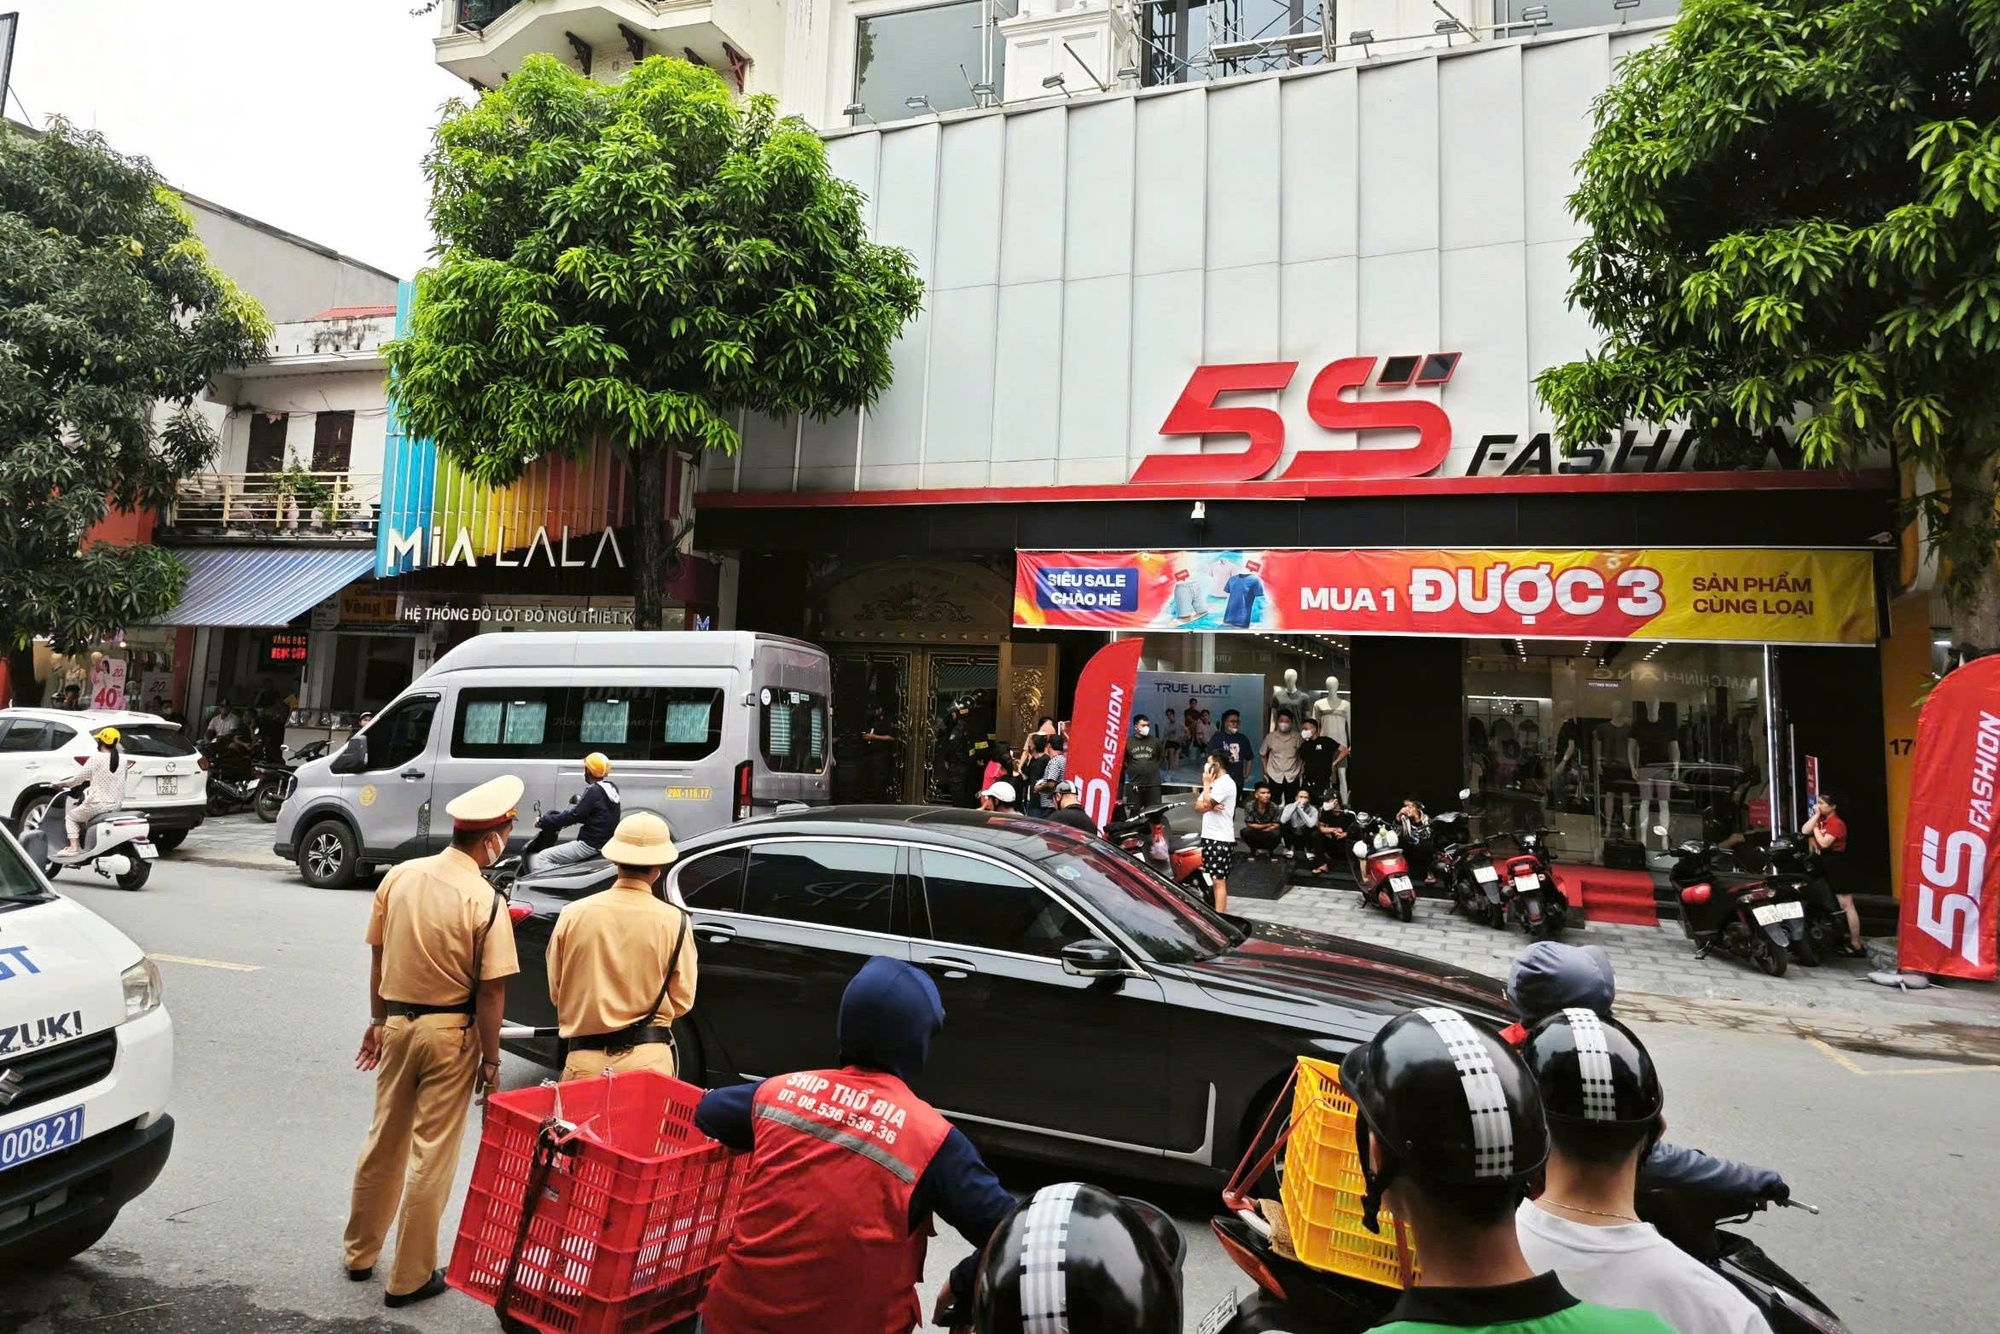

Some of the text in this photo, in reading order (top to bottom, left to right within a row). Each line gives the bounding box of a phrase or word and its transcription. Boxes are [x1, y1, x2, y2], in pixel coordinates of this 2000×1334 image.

[1130, 352, 1462, 484] 5S
[1465, 426, 1815, 477] FASHIN
[1048, 571, 1126, 587] SIÊU SALE
[1300, 562, 1663, 624] MUA 1 ĐƯỢC 3
[1693, 571, 1812, 592] SẢN PHẨM
[404, 604, 421, 623] HỆ
[425, 602, 469, 621] THỐNG
[472, 603, 492, 621] ĐỒ
[624, 610, 635, 625] K
[1051, 590, 1121, 606] CHÀO HÈ
[1693, 595, 1814, 618] CÙNG LOẠI
[95, 688, 117, 707] 40
[1154, 682, 1230, 695] TRUE LIGHT
[1101, 684, 1124, 779] FASHION
[1889, 739, 1916, 755] 17
[1917, 710, 2000, 967] 5S FASHION
[786, 1073, 829, 1094] SHIP
[870, 1099, 906, 1129] ĐỊA
[2, 1110, 77, 1163] 008.21
[797, 1095, 897, 1145] 08.536.536.36
